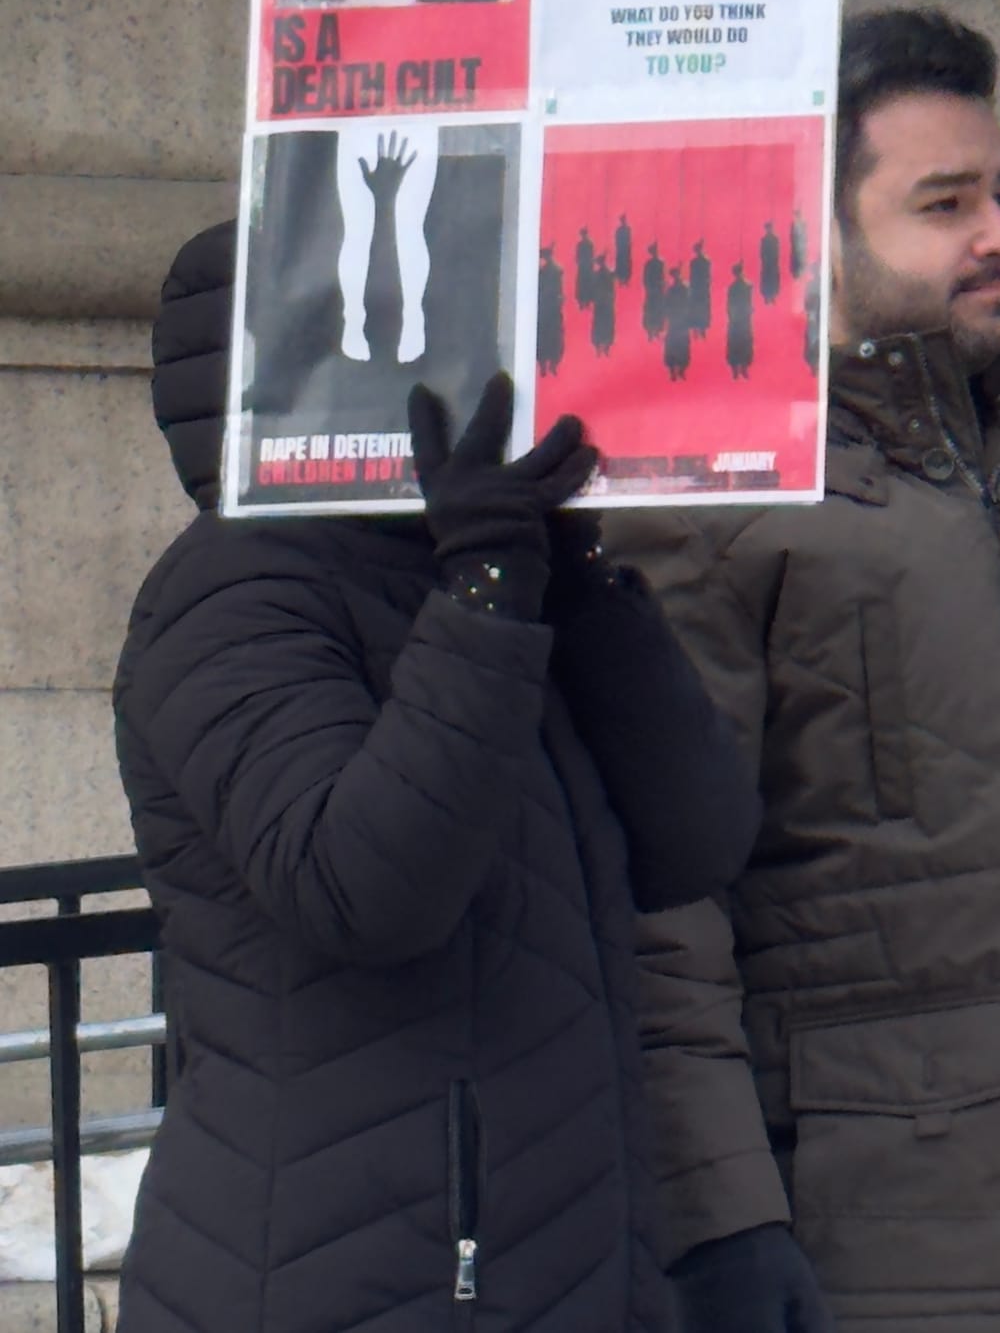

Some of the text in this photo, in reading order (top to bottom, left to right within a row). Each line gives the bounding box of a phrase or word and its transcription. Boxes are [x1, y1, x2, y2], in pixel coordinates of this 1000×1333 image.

[610, 2, 766, 25] WHAT DO YOU THINK
[273, 12, 341, 63] IS A
[626, 27, 748, 47] THEY WOULD DO
[646, 52, 726, 75] TO YOU?
[271, 57, 482, 115] DEATH CULT
[260, 436, 307, 463] RAPE
[310, 434, 330, 460] IN
[258, 457, 357, 487] CHILDREN
[364, 456, 404, 482] NOT
[712, 451, 777, 473] JANUARY
